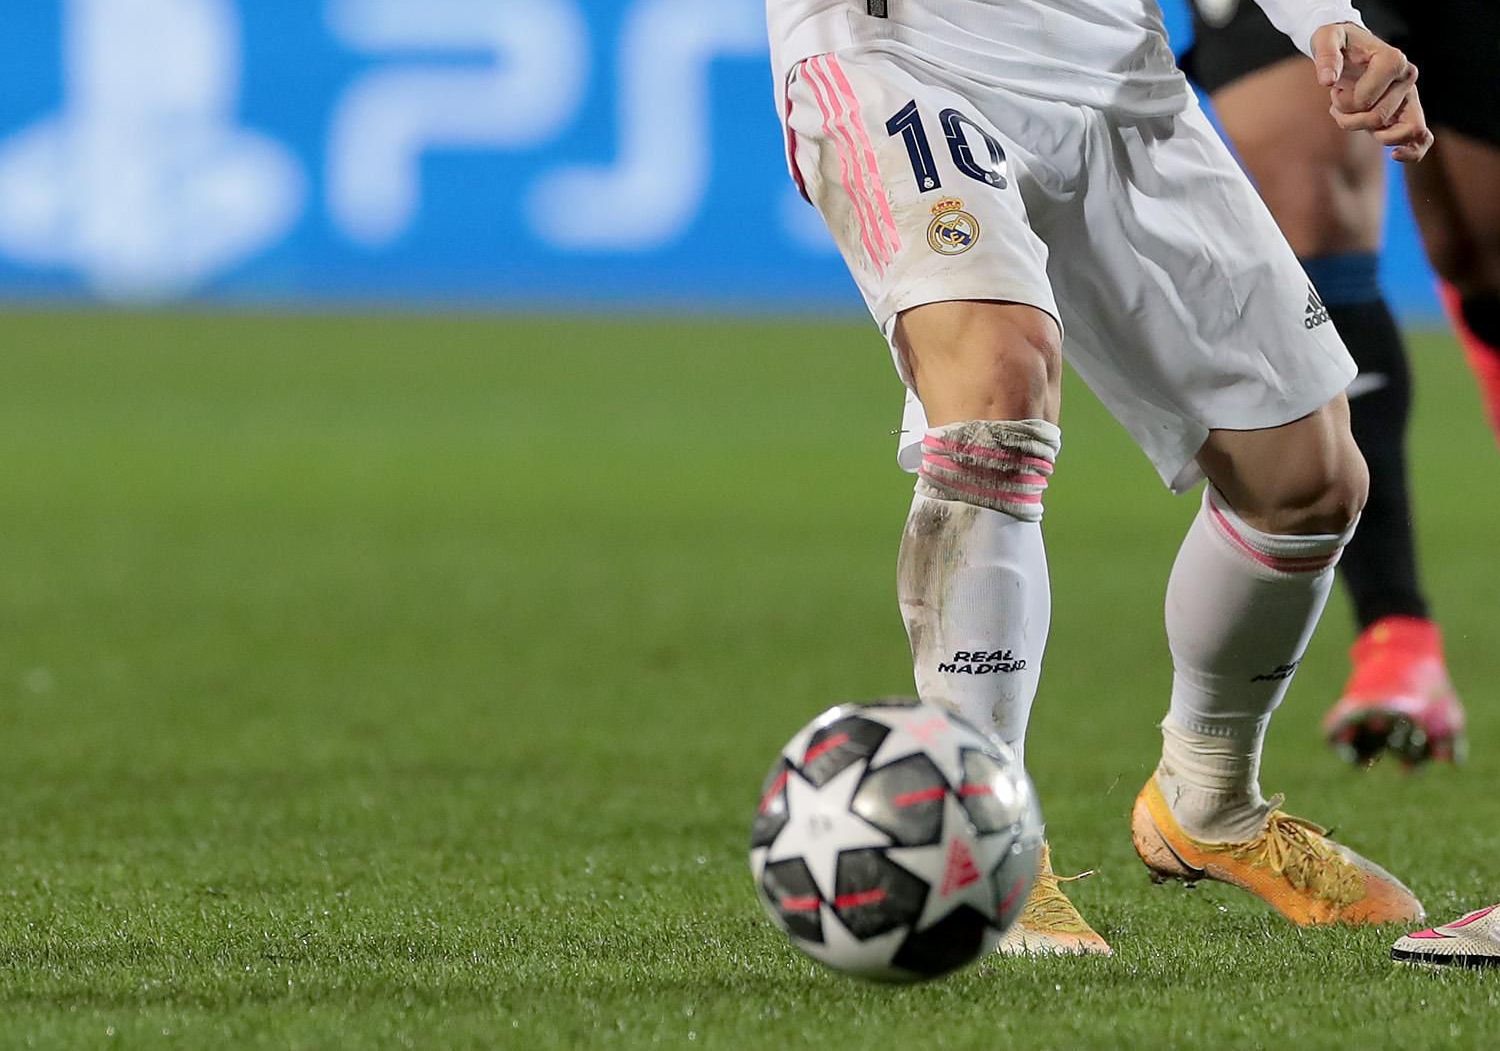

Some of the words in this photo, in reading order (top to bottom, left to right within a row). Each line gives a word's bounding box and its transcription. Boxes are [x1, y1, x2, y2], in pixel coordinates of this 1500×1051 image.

[885, 98, 1008, 194] 10
[953, 650, 1013, 662] REAL
[938, 659, 1027, 675] MADRID
